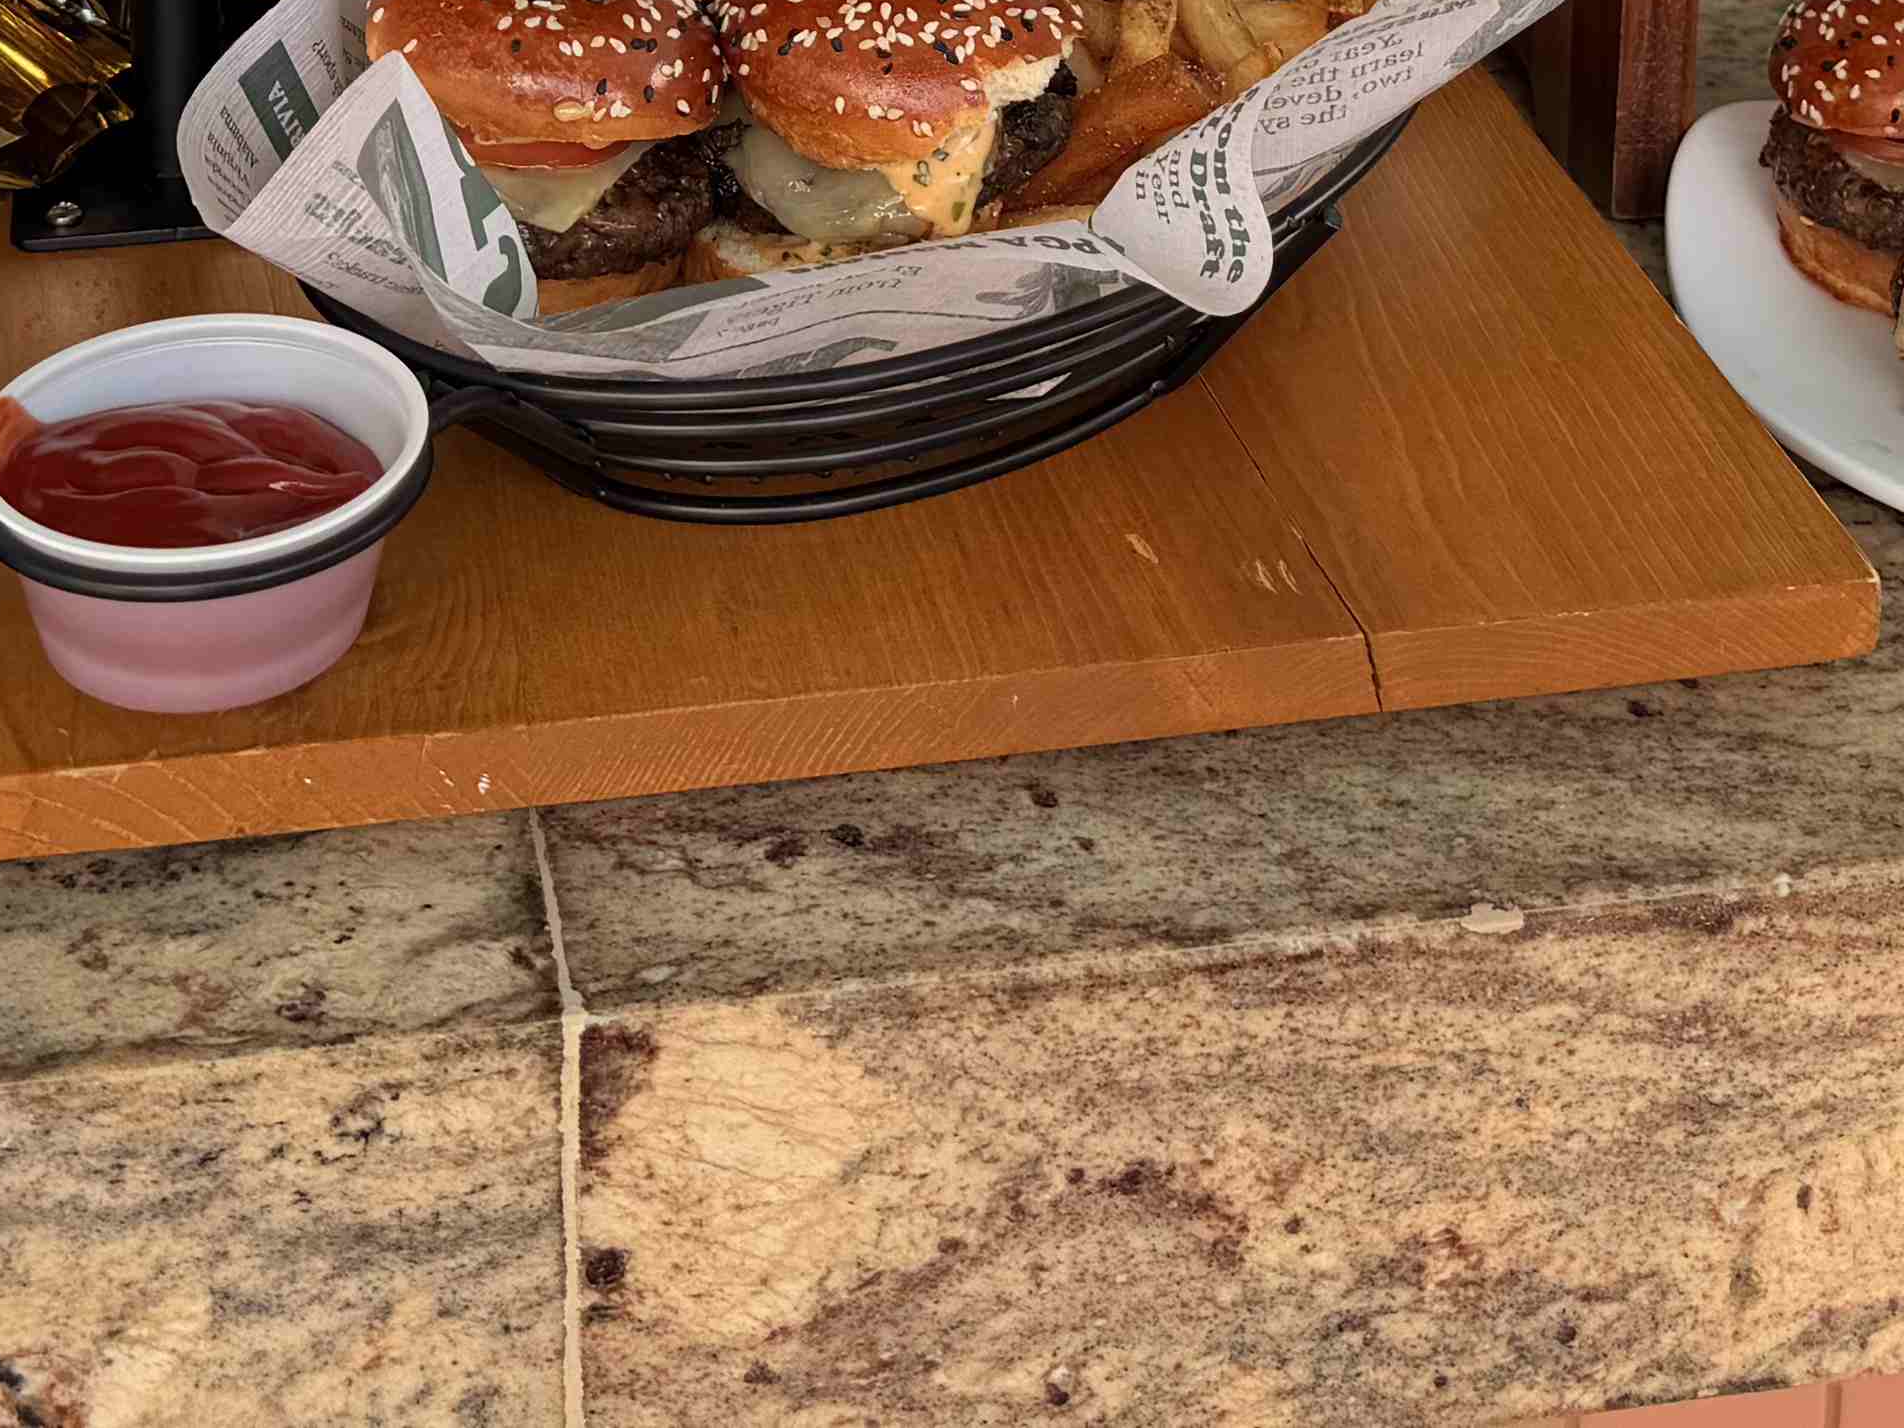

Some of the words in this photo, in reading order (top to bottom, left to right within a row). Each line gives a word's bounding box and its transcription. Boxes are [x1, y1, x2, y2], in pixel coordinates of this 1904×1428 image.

[266, 76, 313, 146] RIVIA
[1188, 149, 1224, 284] Draft
[1224, 201, 1247, 286] the
